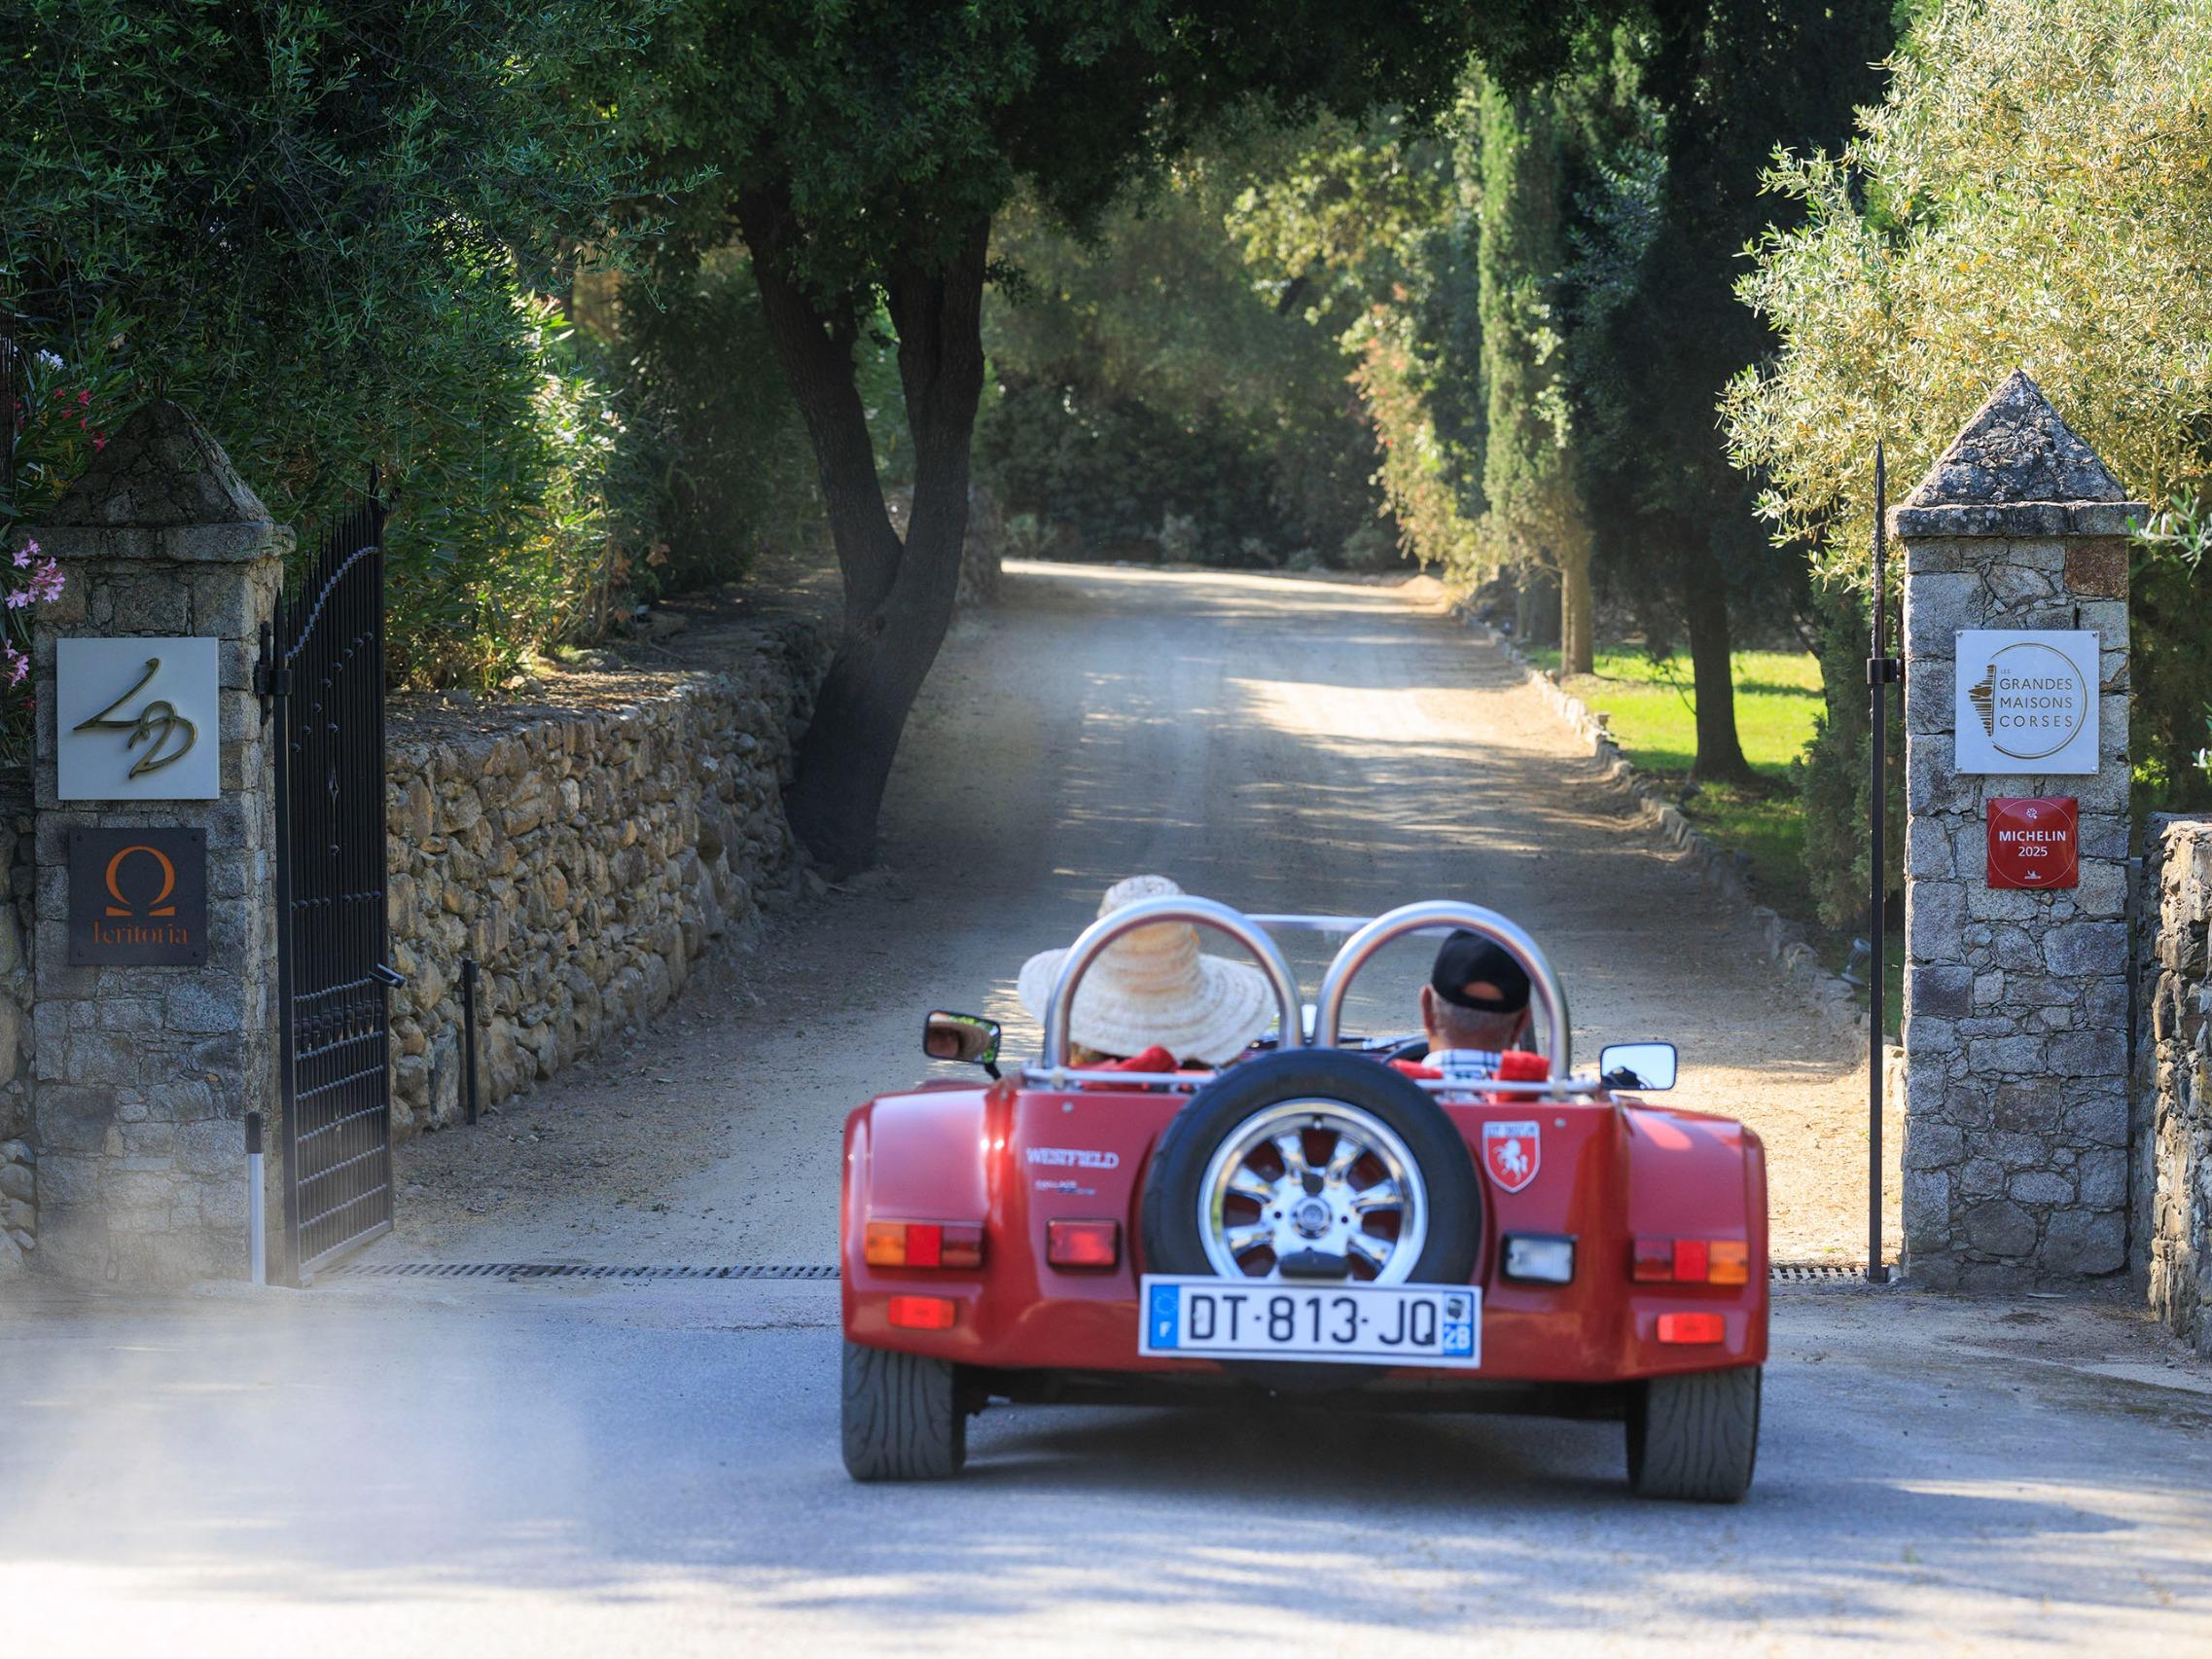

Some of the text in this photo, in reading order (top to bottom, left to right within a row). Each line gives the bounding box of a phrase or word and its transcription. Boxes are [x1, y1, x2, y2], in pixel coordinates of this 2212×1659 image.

[1999, 678, 2073, 690] GRANDES
[2000, 697, 2073, 708] MAISONS
[1999, 715, 2073, 728] CORSES
[1999, 830, 2066, 842] MICHELIN
[2017, 846, 2048, 857] 2025
[1026, 1147, 1120, 1169] WESTFIELD
